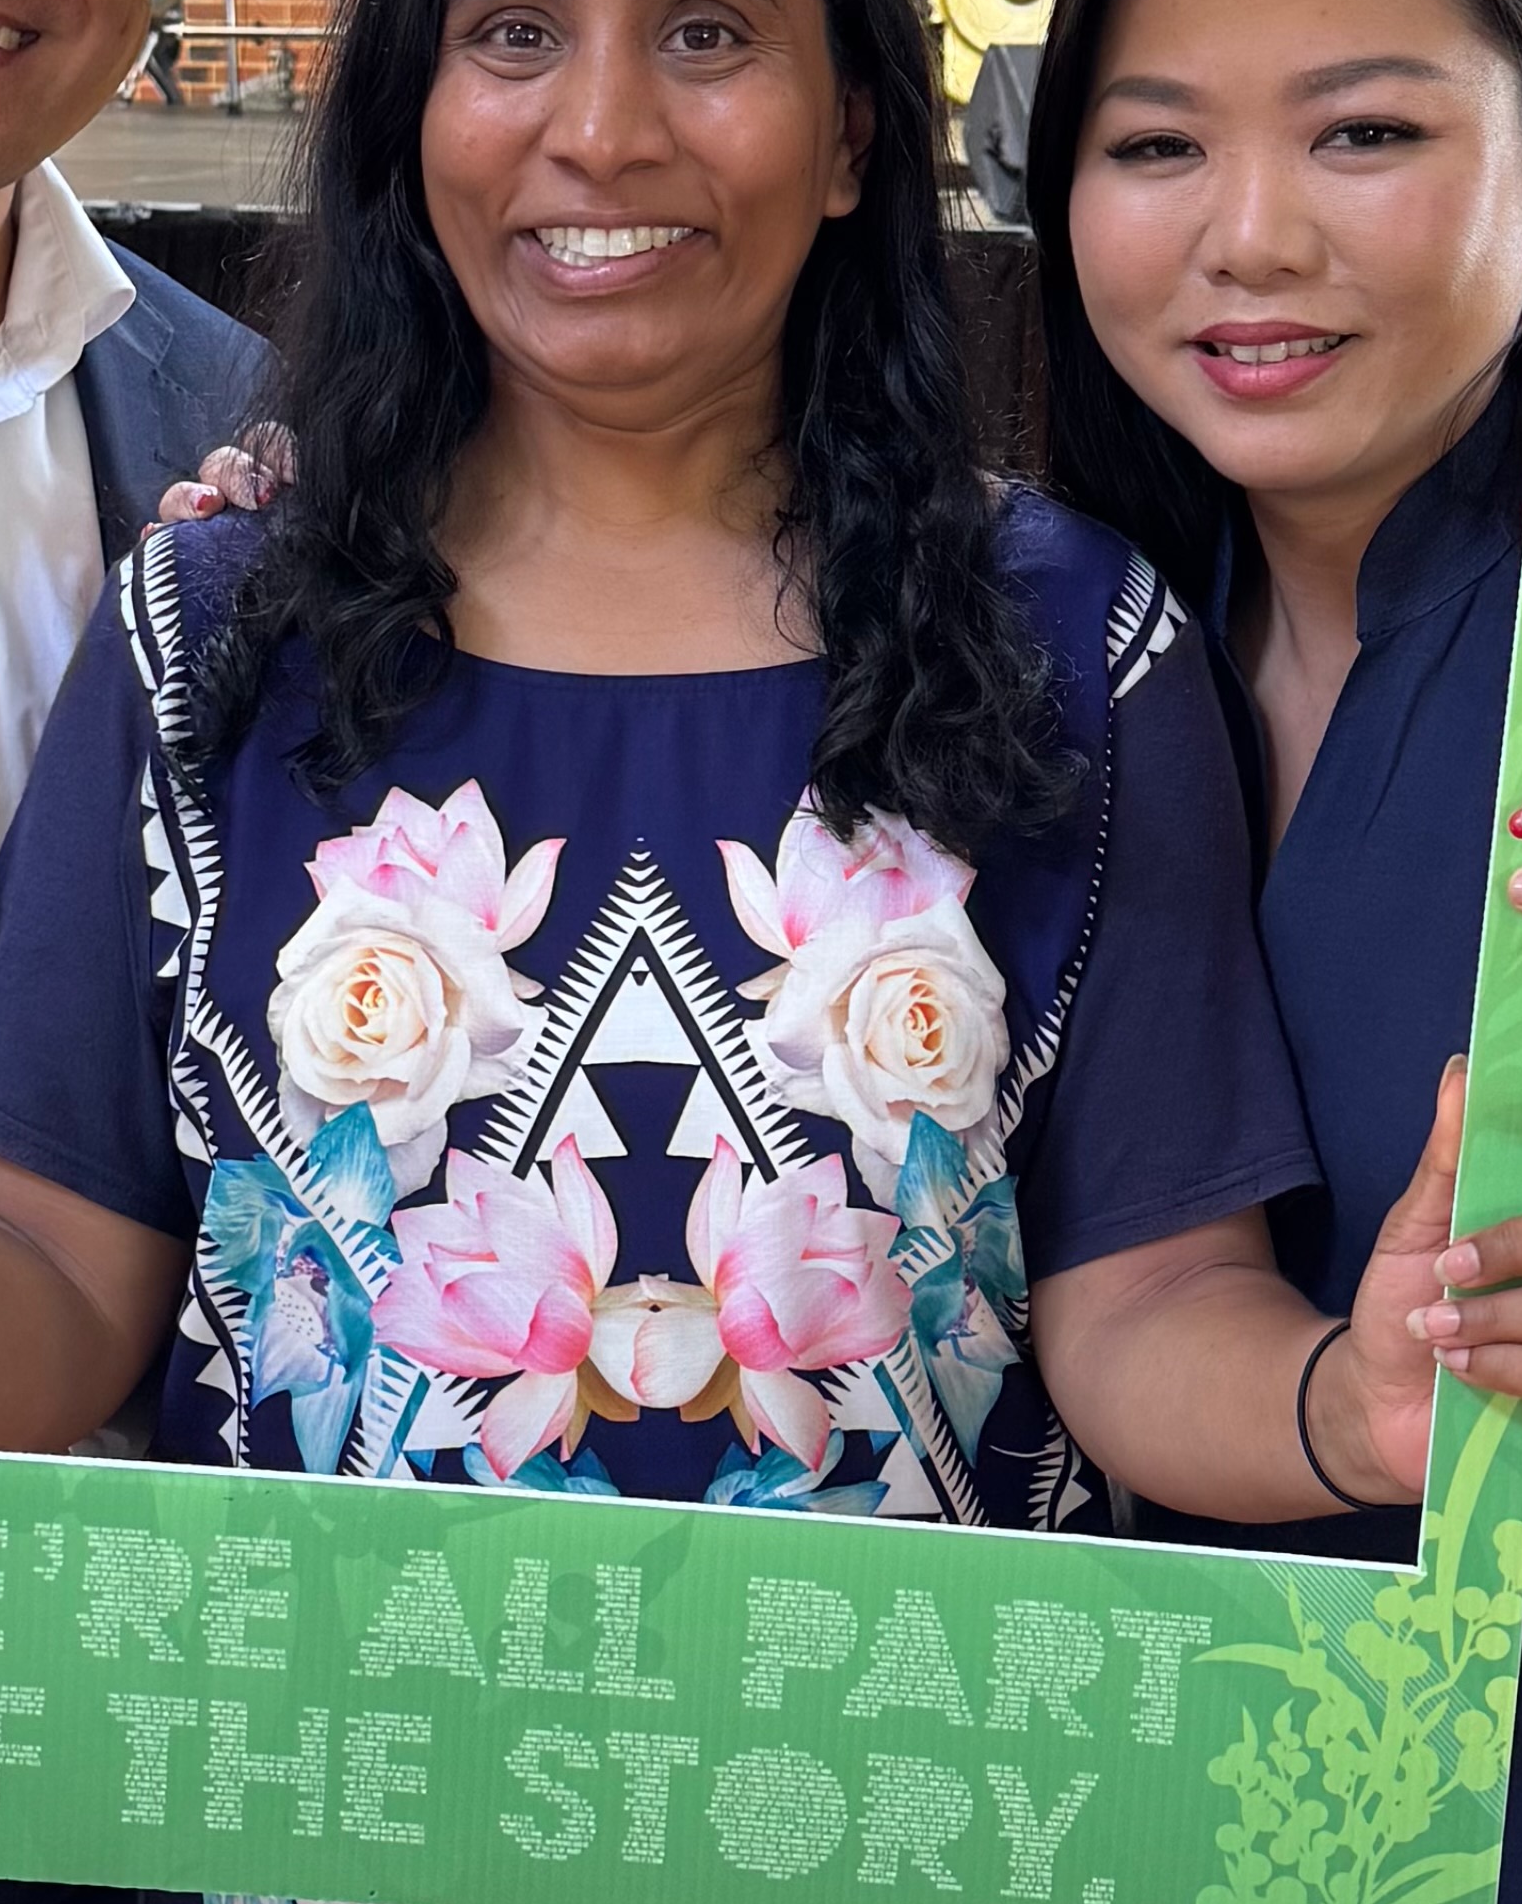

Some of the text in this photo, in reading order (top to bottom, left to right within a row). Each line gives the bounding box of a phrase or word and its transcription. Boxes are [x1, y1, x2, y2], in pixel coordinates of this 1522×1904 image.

[349, 1549, 676, 1701] ALL
[741, 1576, 1213, 1746] PART
[106, 1692, 432, 1845] THE
